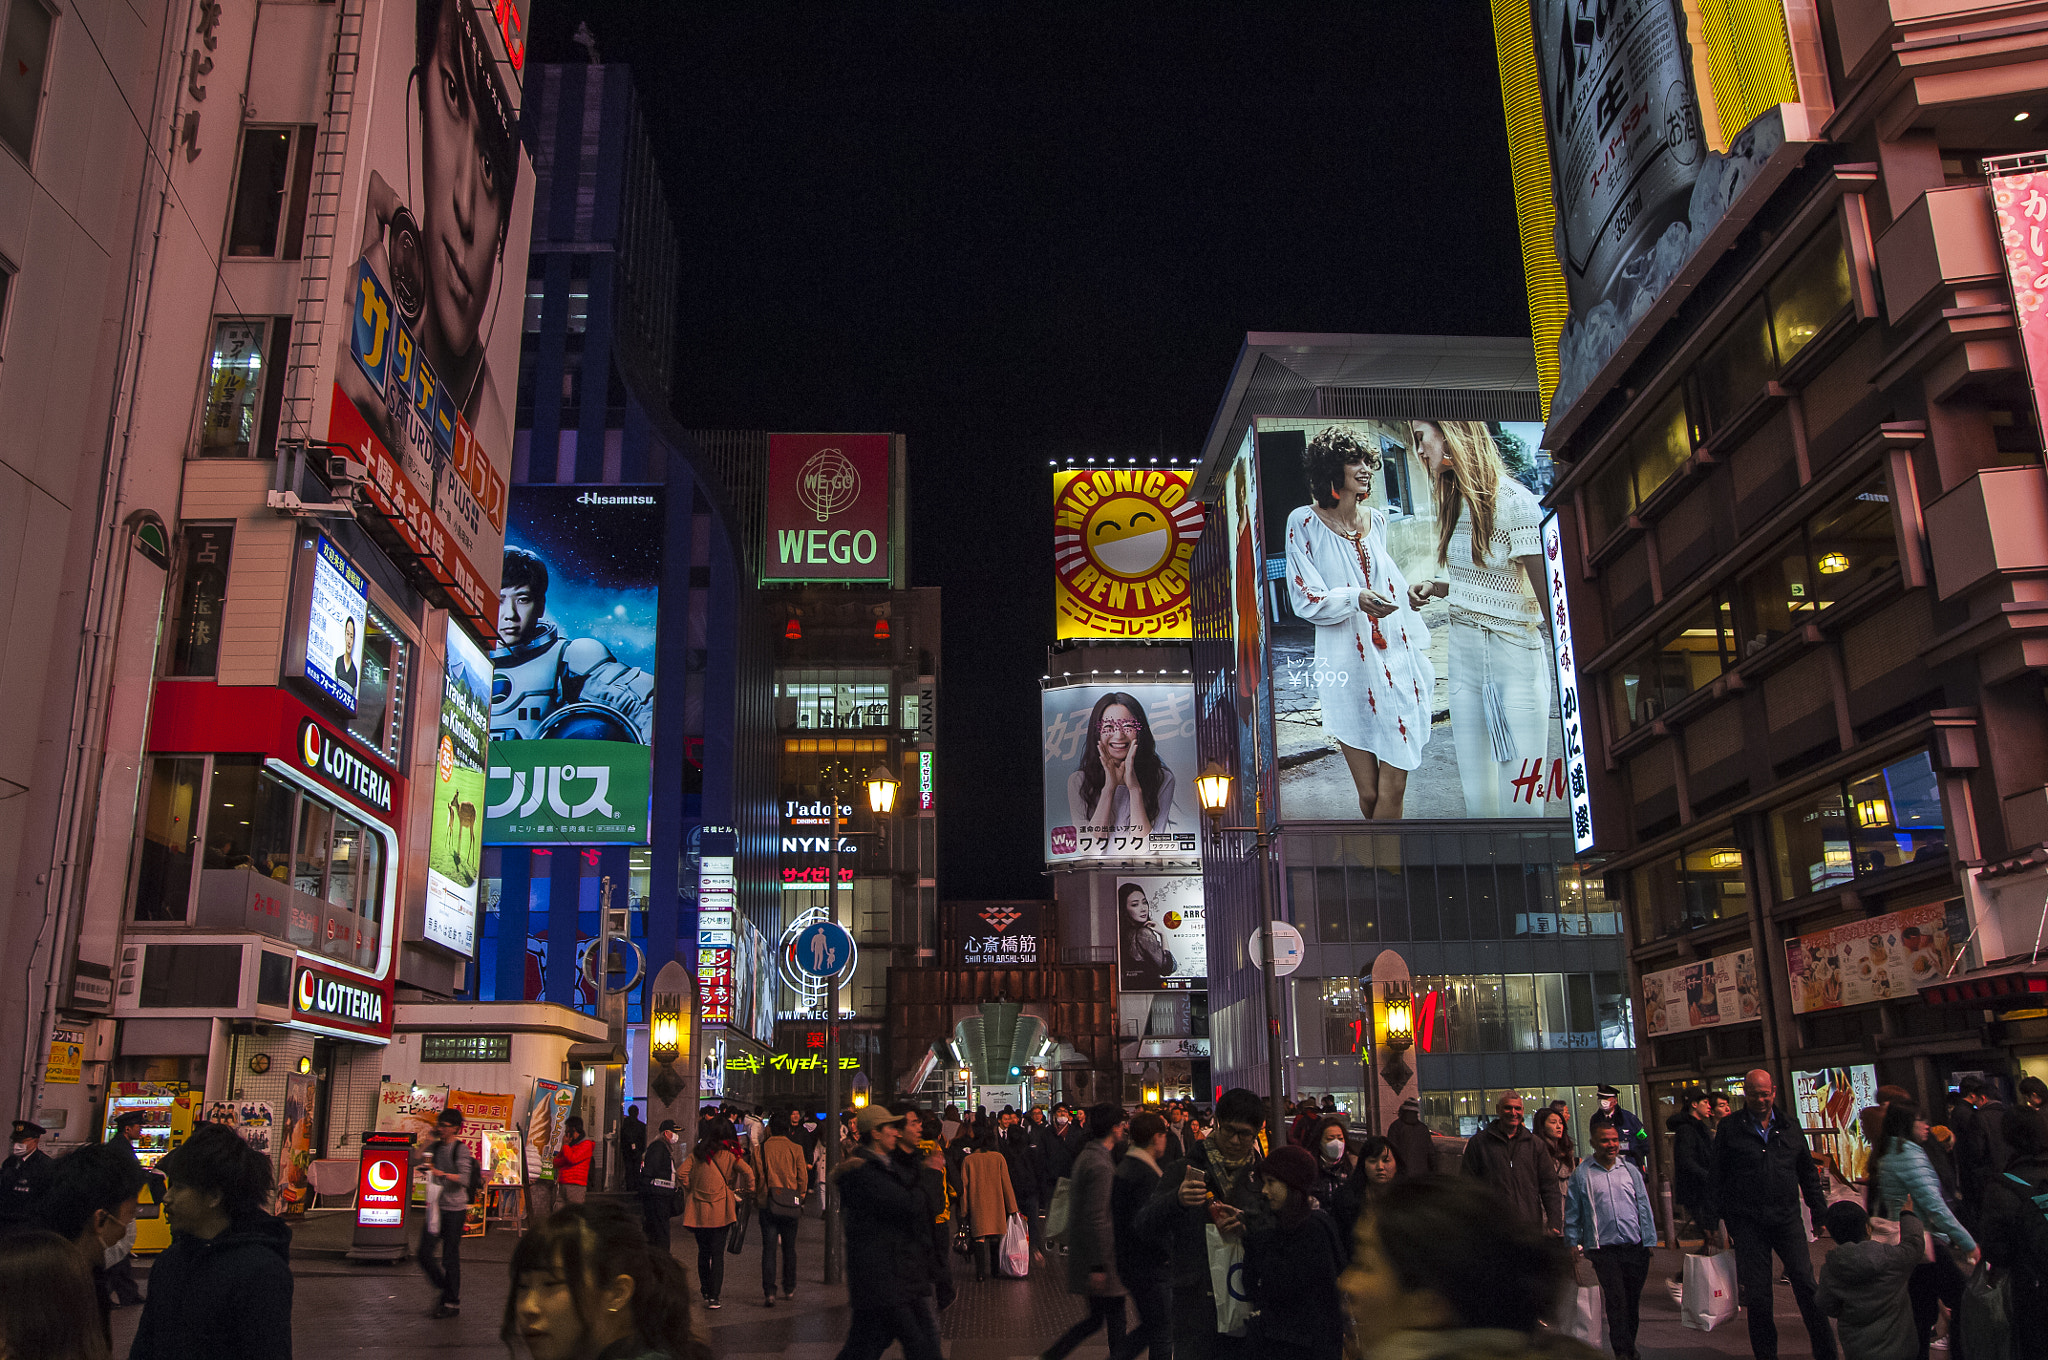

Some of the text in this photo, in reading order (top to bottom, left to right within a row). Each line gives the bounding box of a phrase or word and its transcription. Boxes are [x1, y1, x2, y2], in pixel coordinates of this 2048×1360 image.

[1597, 64, 1630, 143] 生
[1667, 101, 1696, 148] お酒
[1590, 91, 1649, 199] スーパードライ
[1614, 188, 1643, 242] 350ml
[361, 276, 504, 523] サタデー プラス
[448, 470, 472, 522] PLUS
[1055, 470, 1185, 530] NICONICO
[777, 529, 877, 564] WEGO
[1071, 542, 1196, 611] RENTACAR
[1286, 656, 1331, 668] トップス
[1288, 670, 1349, 690] ¥1,999
[445, 674, 467, 713] Travel
[471, 701, 487, 732] Nara
[921, 689, 933, 736] NYNY
[323, 737, 391, 812] LOTTERIA
[1079, 825, 1144, 834] 運命の出会いアプリ
[1079, 836, 1144, 852] ワクワク
[964, 934, 1037, 953] 心斎橋筋
[317, 978, 382, 1023] LOTTERIA
[700, 977, 713, 1015] コミック
[715, 949, 729, 1015] インターネット
[777, 1010, 857, 1020] WWW.WEG.JP
[807, 1031, 825, 1048] 薬
[396, 1104, 442, 1115] エビバーガー
[452, 1103, 508, 1118] 本日限定!
[364, 1194, 399, 1202] LOTTERIA
